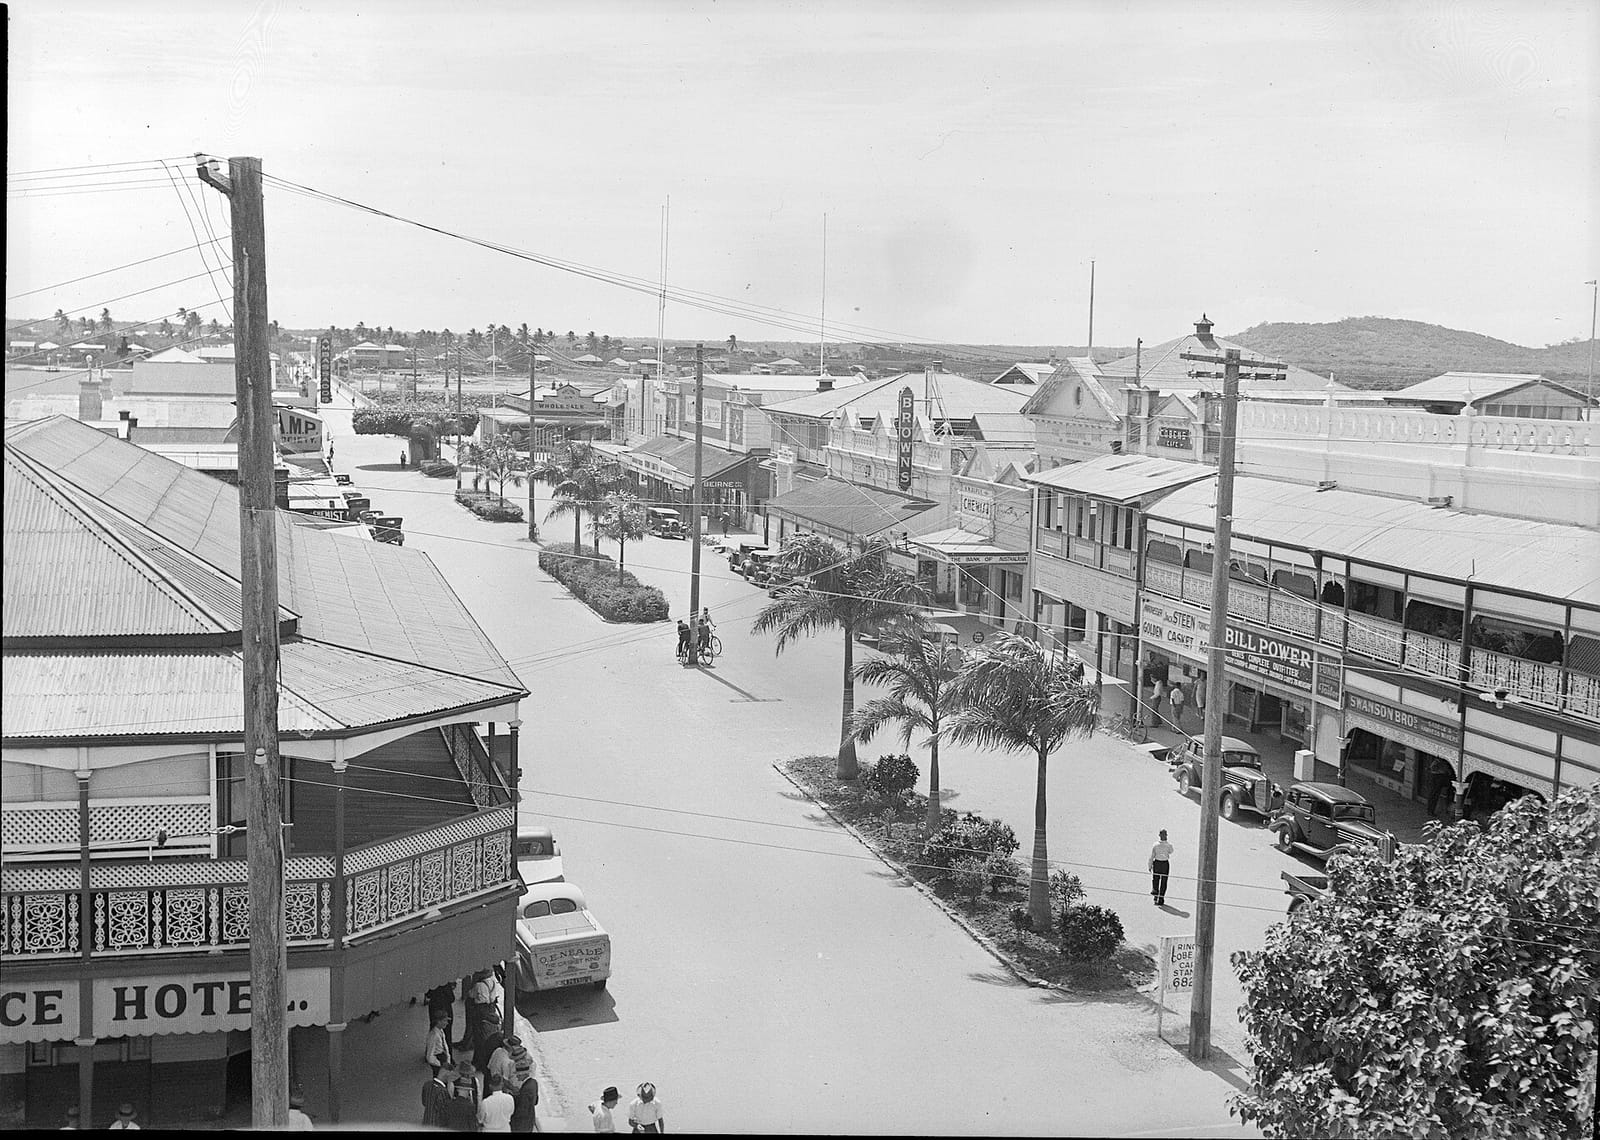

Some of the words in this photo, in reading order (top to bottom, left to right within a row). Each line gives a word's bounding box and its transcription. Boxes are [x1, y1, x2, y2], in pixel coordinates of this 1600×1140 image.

[900, 397, 912, 483] BROWNS
[1143, 621, 1162, 639] GOLDEN
[1167, 630, 1194, 649] CASKET
[1173, 611, 1195, 631] STEEN
[1225, 627, 1256, 652] BILL
[1259, 638, 1310, 668] POWER
[1350, 695, 1394, 720] SWANSON
[112, 981, 309, 1022] HOTE.
